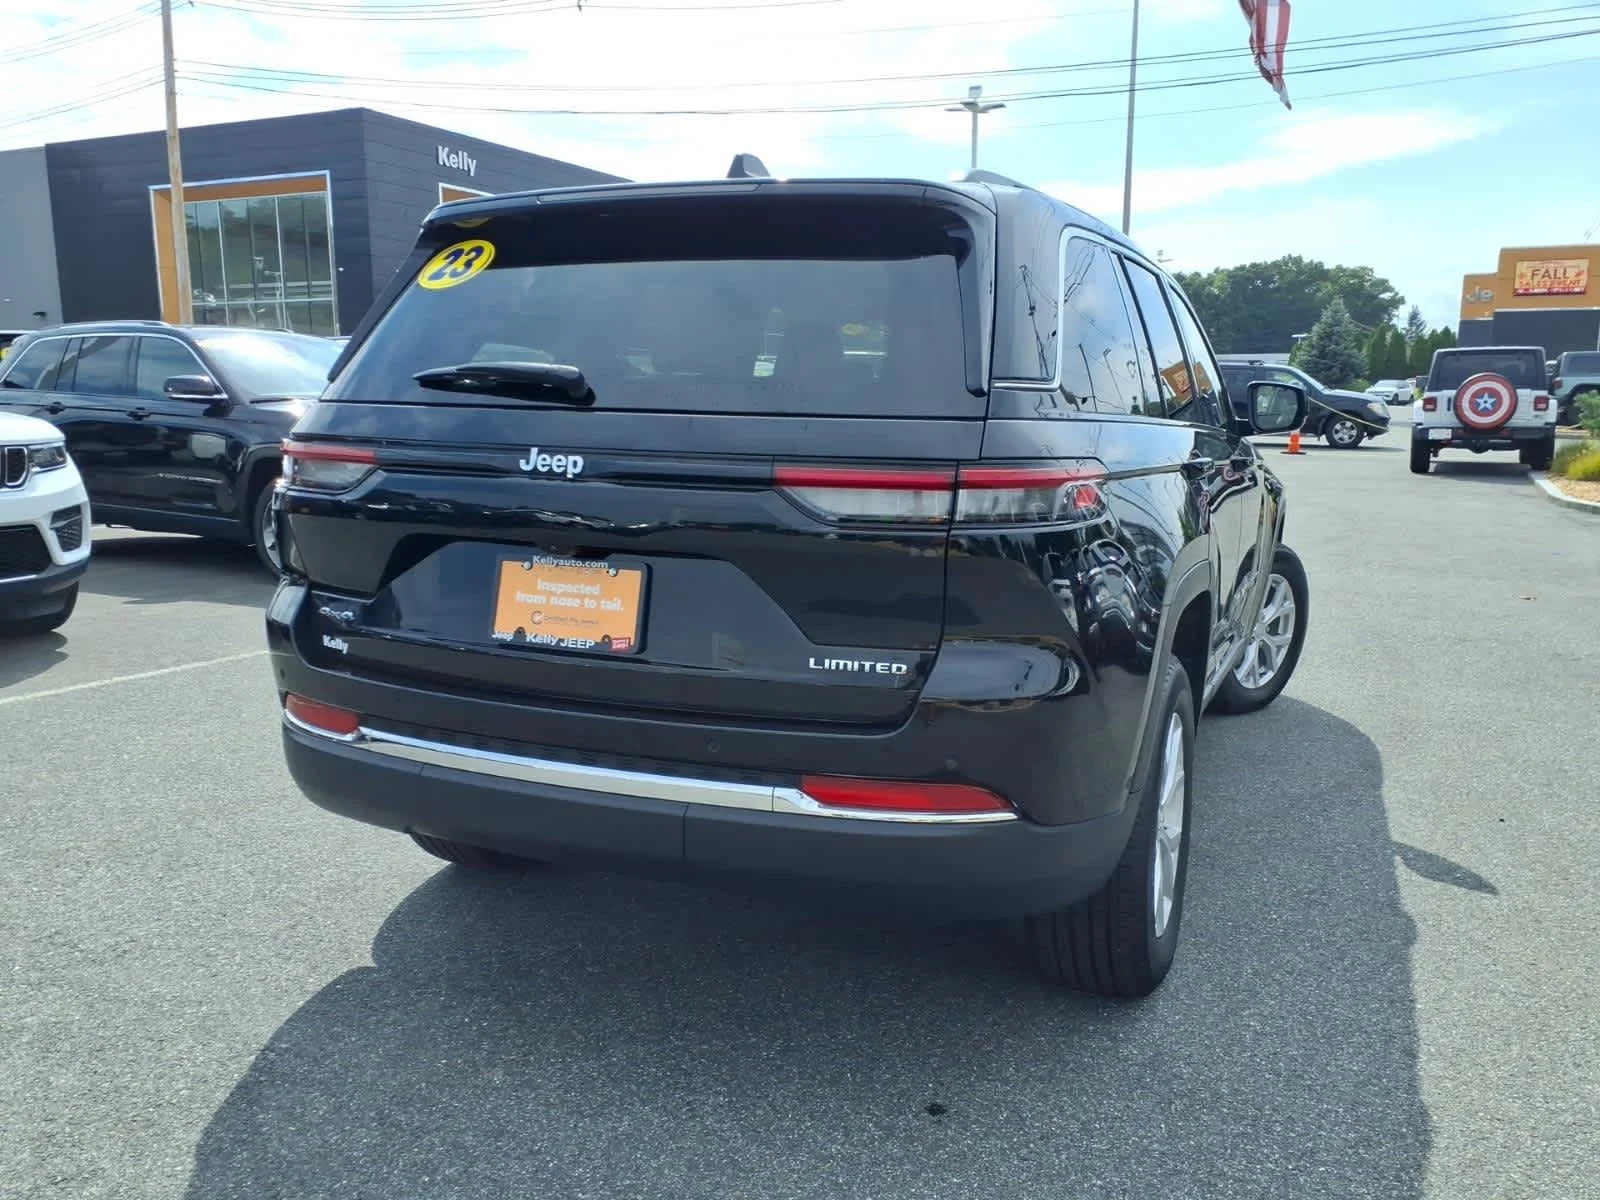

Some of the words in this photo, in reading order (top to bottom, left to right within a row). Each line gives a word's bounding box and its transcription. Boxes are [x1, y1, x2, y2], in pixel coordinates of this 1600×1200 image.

[438, 145, 477, 177] Kelly
[428, 245, 485, 281] 23
[1530, 267, 1571, 281] FALL
[519, 447, 584, 478] Jeep
[532, 555, 609, 569] Kellyauto.com
[537, 579, 601, 596] Inspected
[515, 591, 547, 605] from
[549, 596, 581, 608] nose
[583, 597, 598, 609] to
[322, 634, 349, 655] Kelly
[525, 632, 559, 647] Kelly
[559, 637, 596, 649] JEEP
[808, 656, 908, 675] LIMITED
